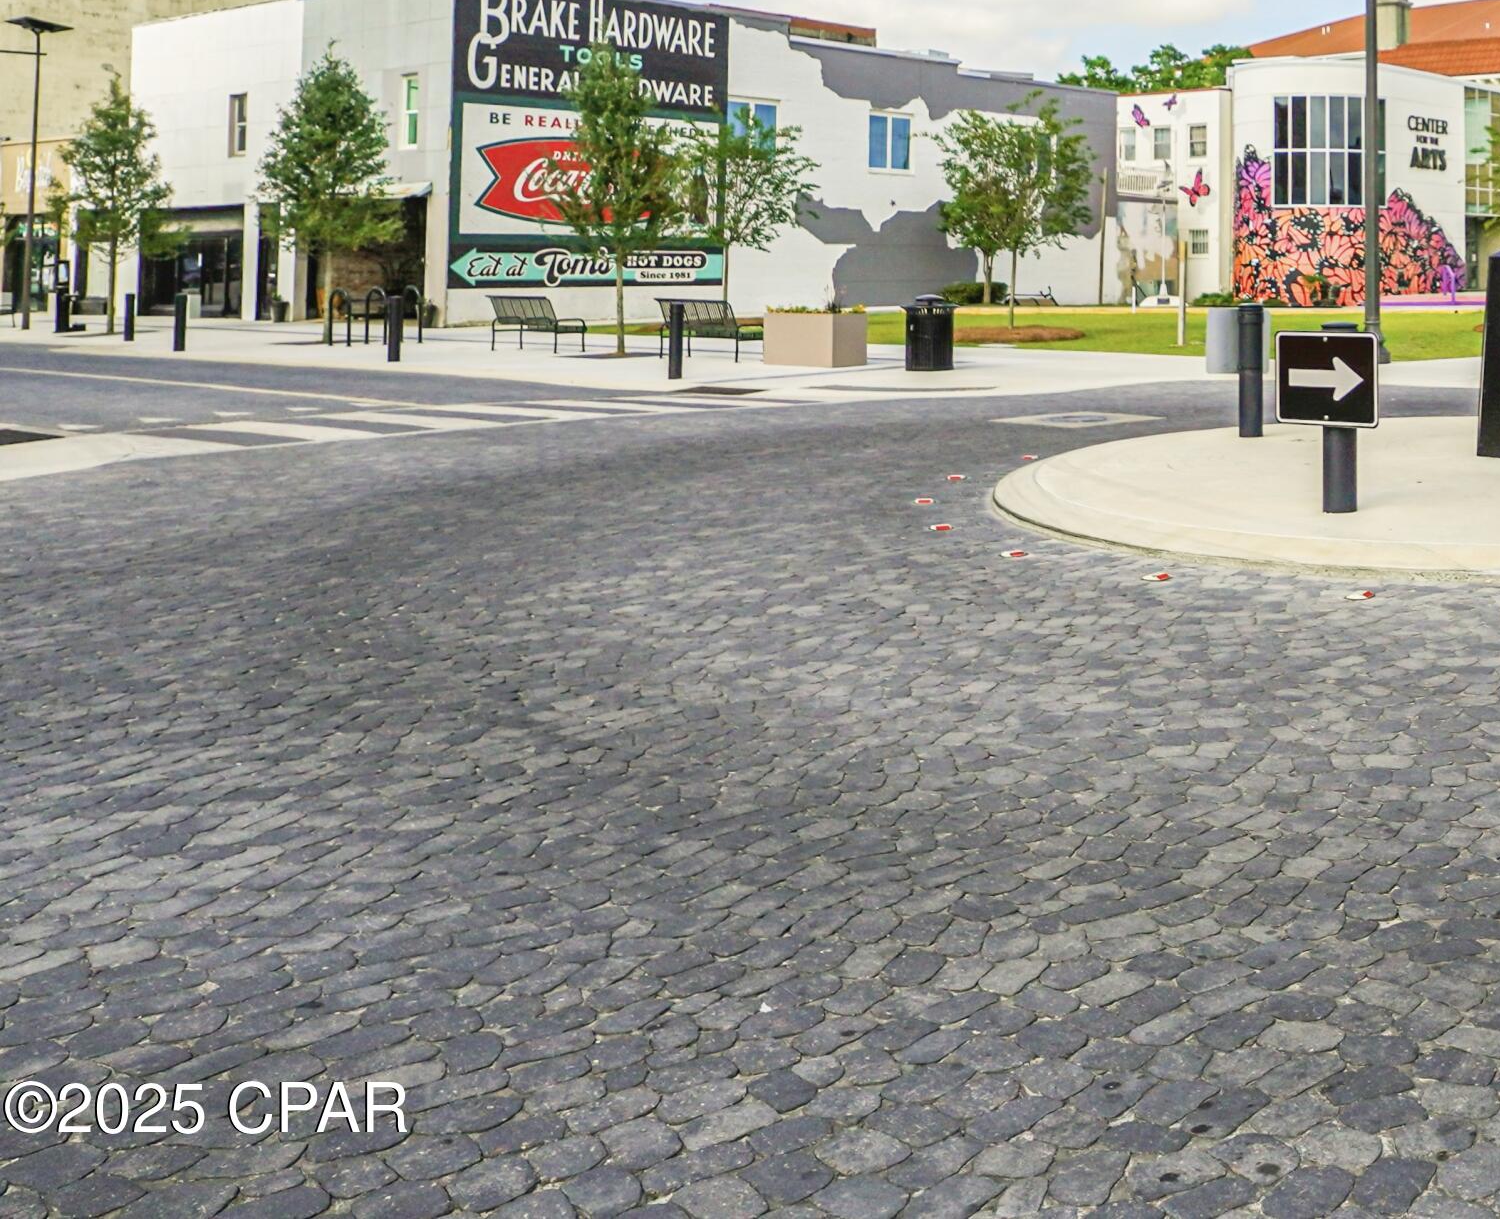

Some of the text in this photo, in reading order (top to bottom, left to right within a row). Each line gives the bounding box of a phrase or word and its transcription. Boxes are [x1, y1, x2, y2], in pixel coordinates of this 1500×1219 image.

[598, 77, 714, 107] DWARE
[489, 112, 511, 125] BE
[1407, 115, 1448, 135] CENTER
[1410, 146, 1447, 171] ARTS
[467, 255, 503, 277] Eat
[506, 255, 528, 277] at
[627, 255, 702, 267] HOT DOGS
[640, 270, 666, 279] Since
